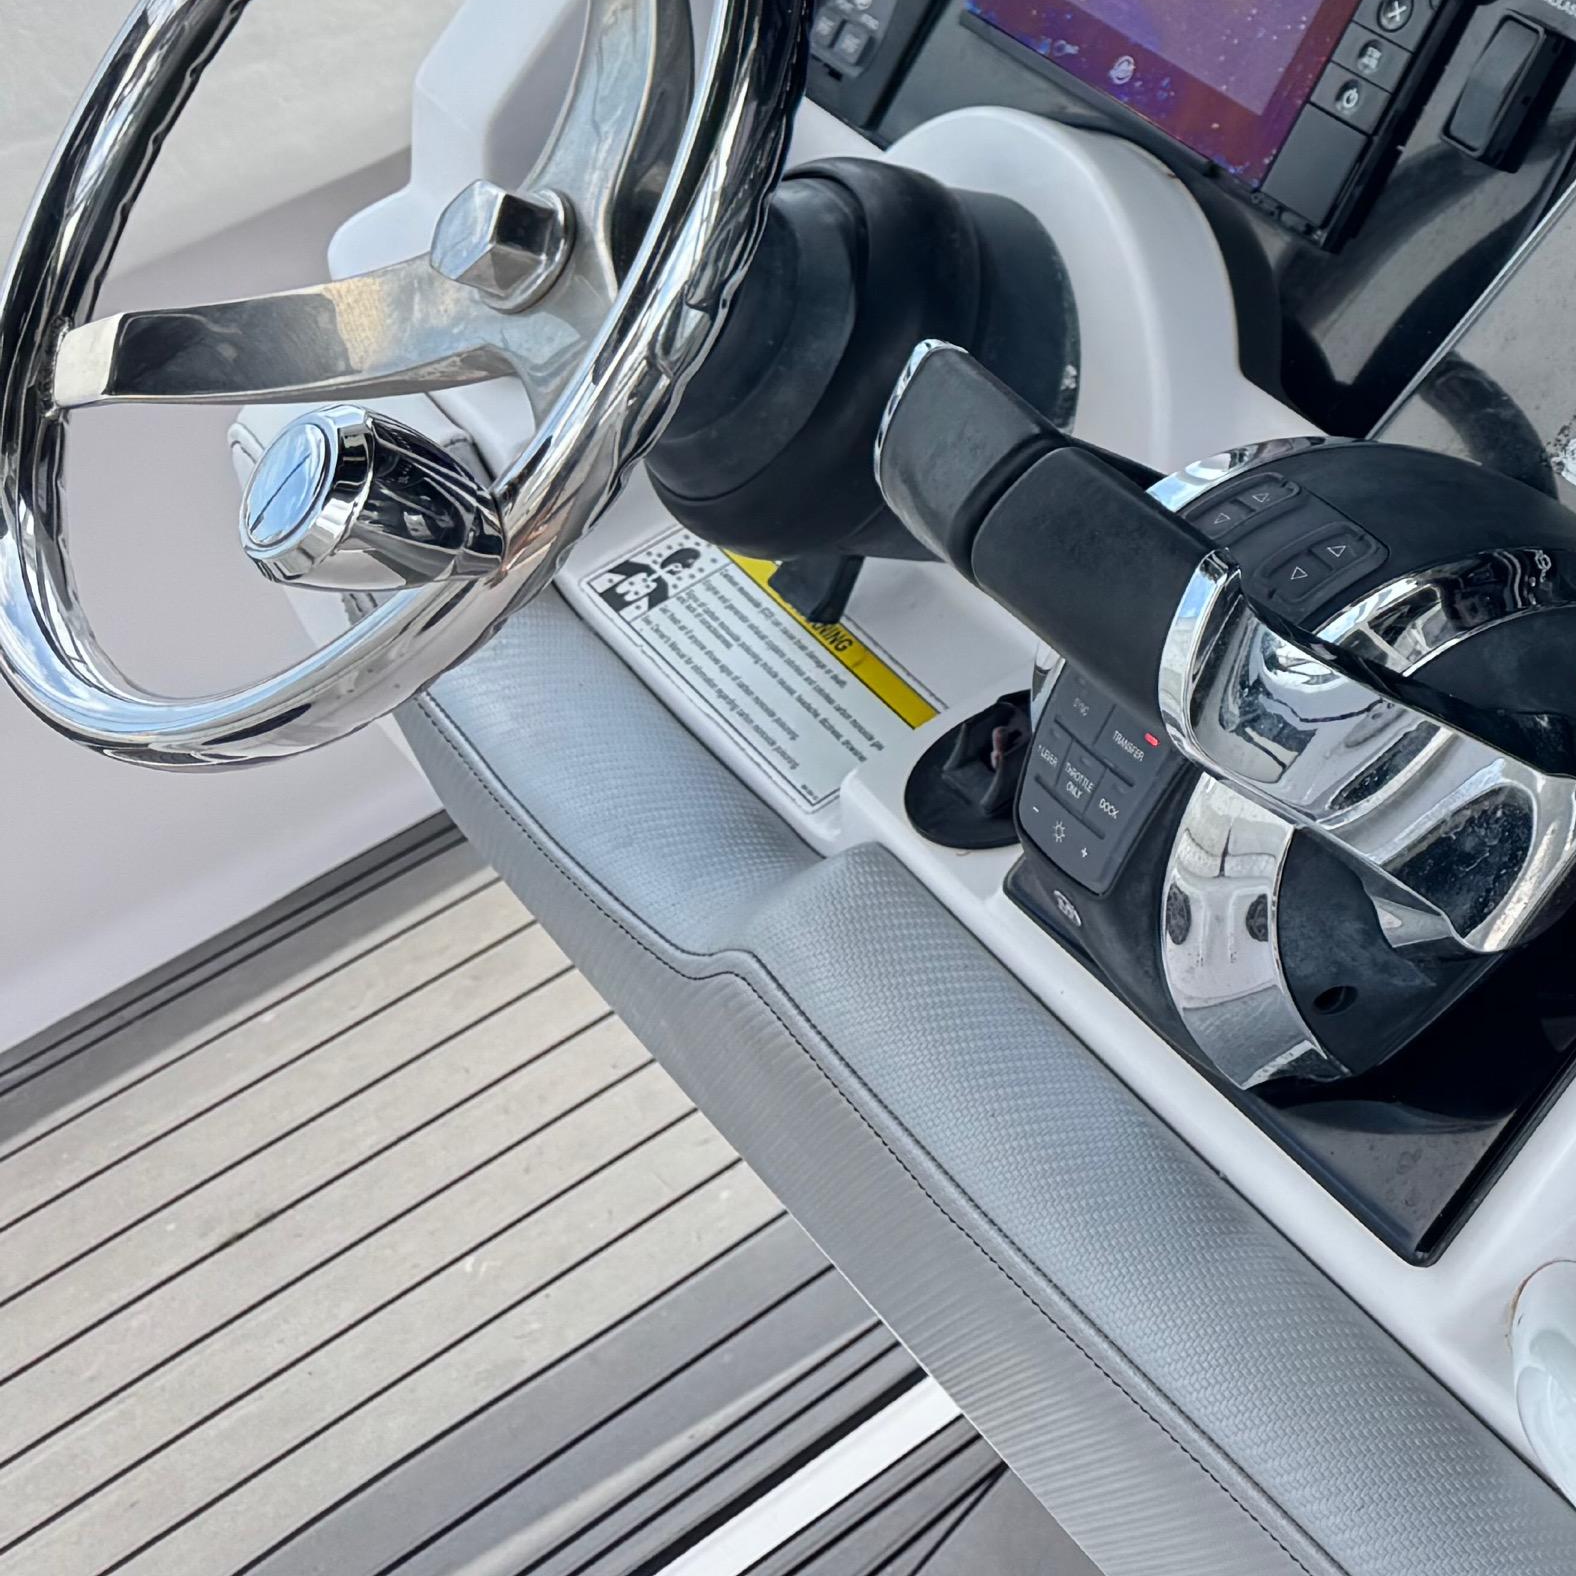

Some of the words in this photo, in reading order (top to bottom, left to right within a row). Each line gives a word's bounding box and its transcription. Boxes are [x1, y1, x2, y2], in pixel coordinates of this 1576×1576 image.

[1113, 730, 1145, 762] TRANSFER
[1065, 762, 1095, 793] THROTTLE
[1066, 781, 1083, 799] ONLY
[1099, 798, 1120, 819] DOCK
